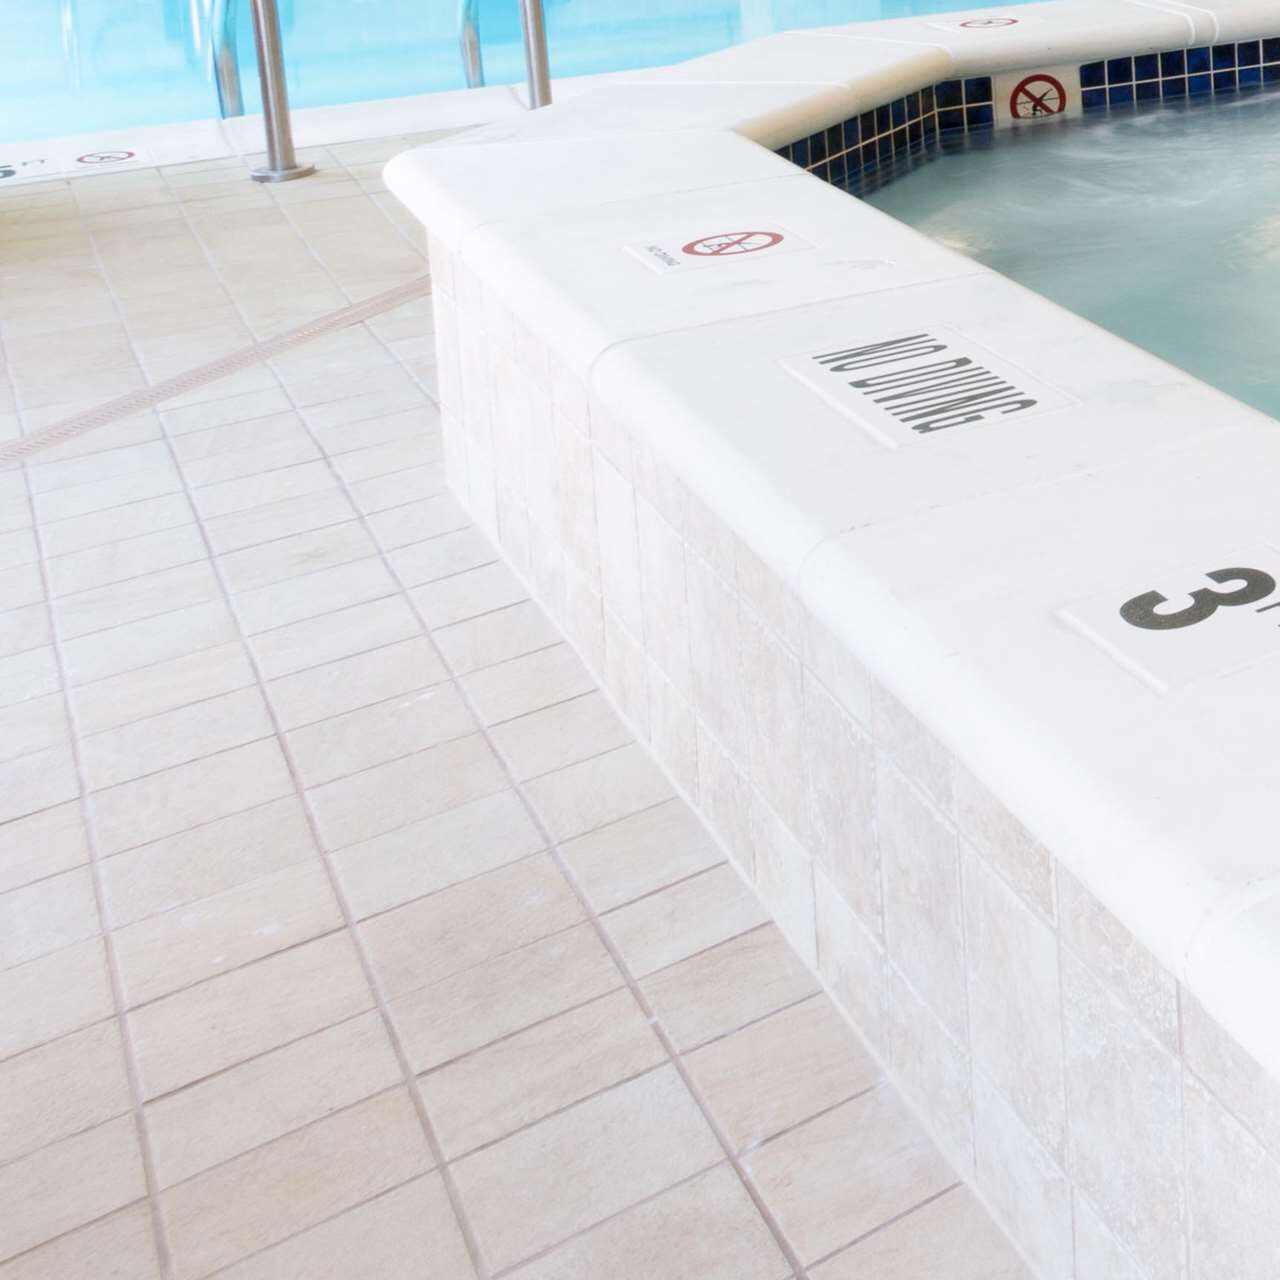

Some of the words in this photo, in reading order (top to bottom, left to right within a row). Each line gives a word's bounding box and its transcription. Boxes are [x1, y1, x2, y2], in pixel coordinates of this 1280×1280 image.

[811, 332, 949, 373] NO
[848, 356, 1038, 435] DIVING
[1119, 567, 1277, 630] 3
